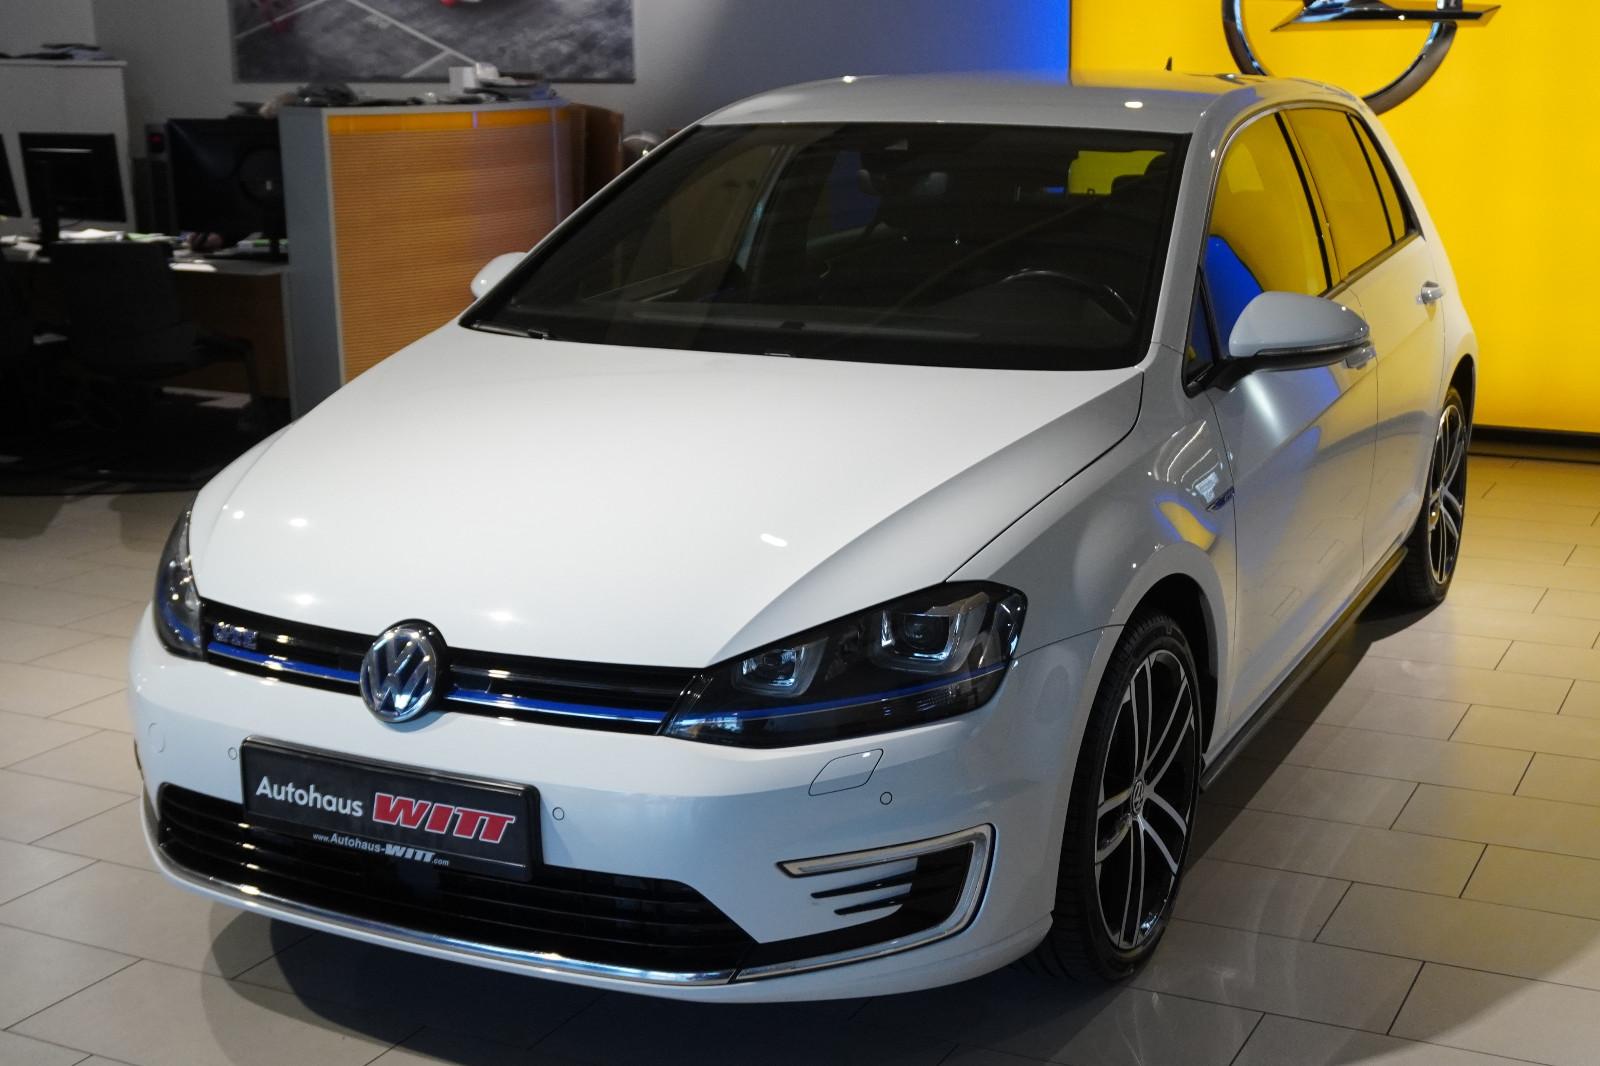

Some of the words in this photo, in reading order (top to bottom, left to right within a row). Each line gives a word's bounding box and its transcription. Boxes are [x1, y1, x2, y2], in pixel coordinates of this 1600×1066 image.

[255, 776, 364, 817] Autohaus
[372, 792, 516, 845] WITT
[312, 833, 449, 866] www.Autohaus-WITT.com
